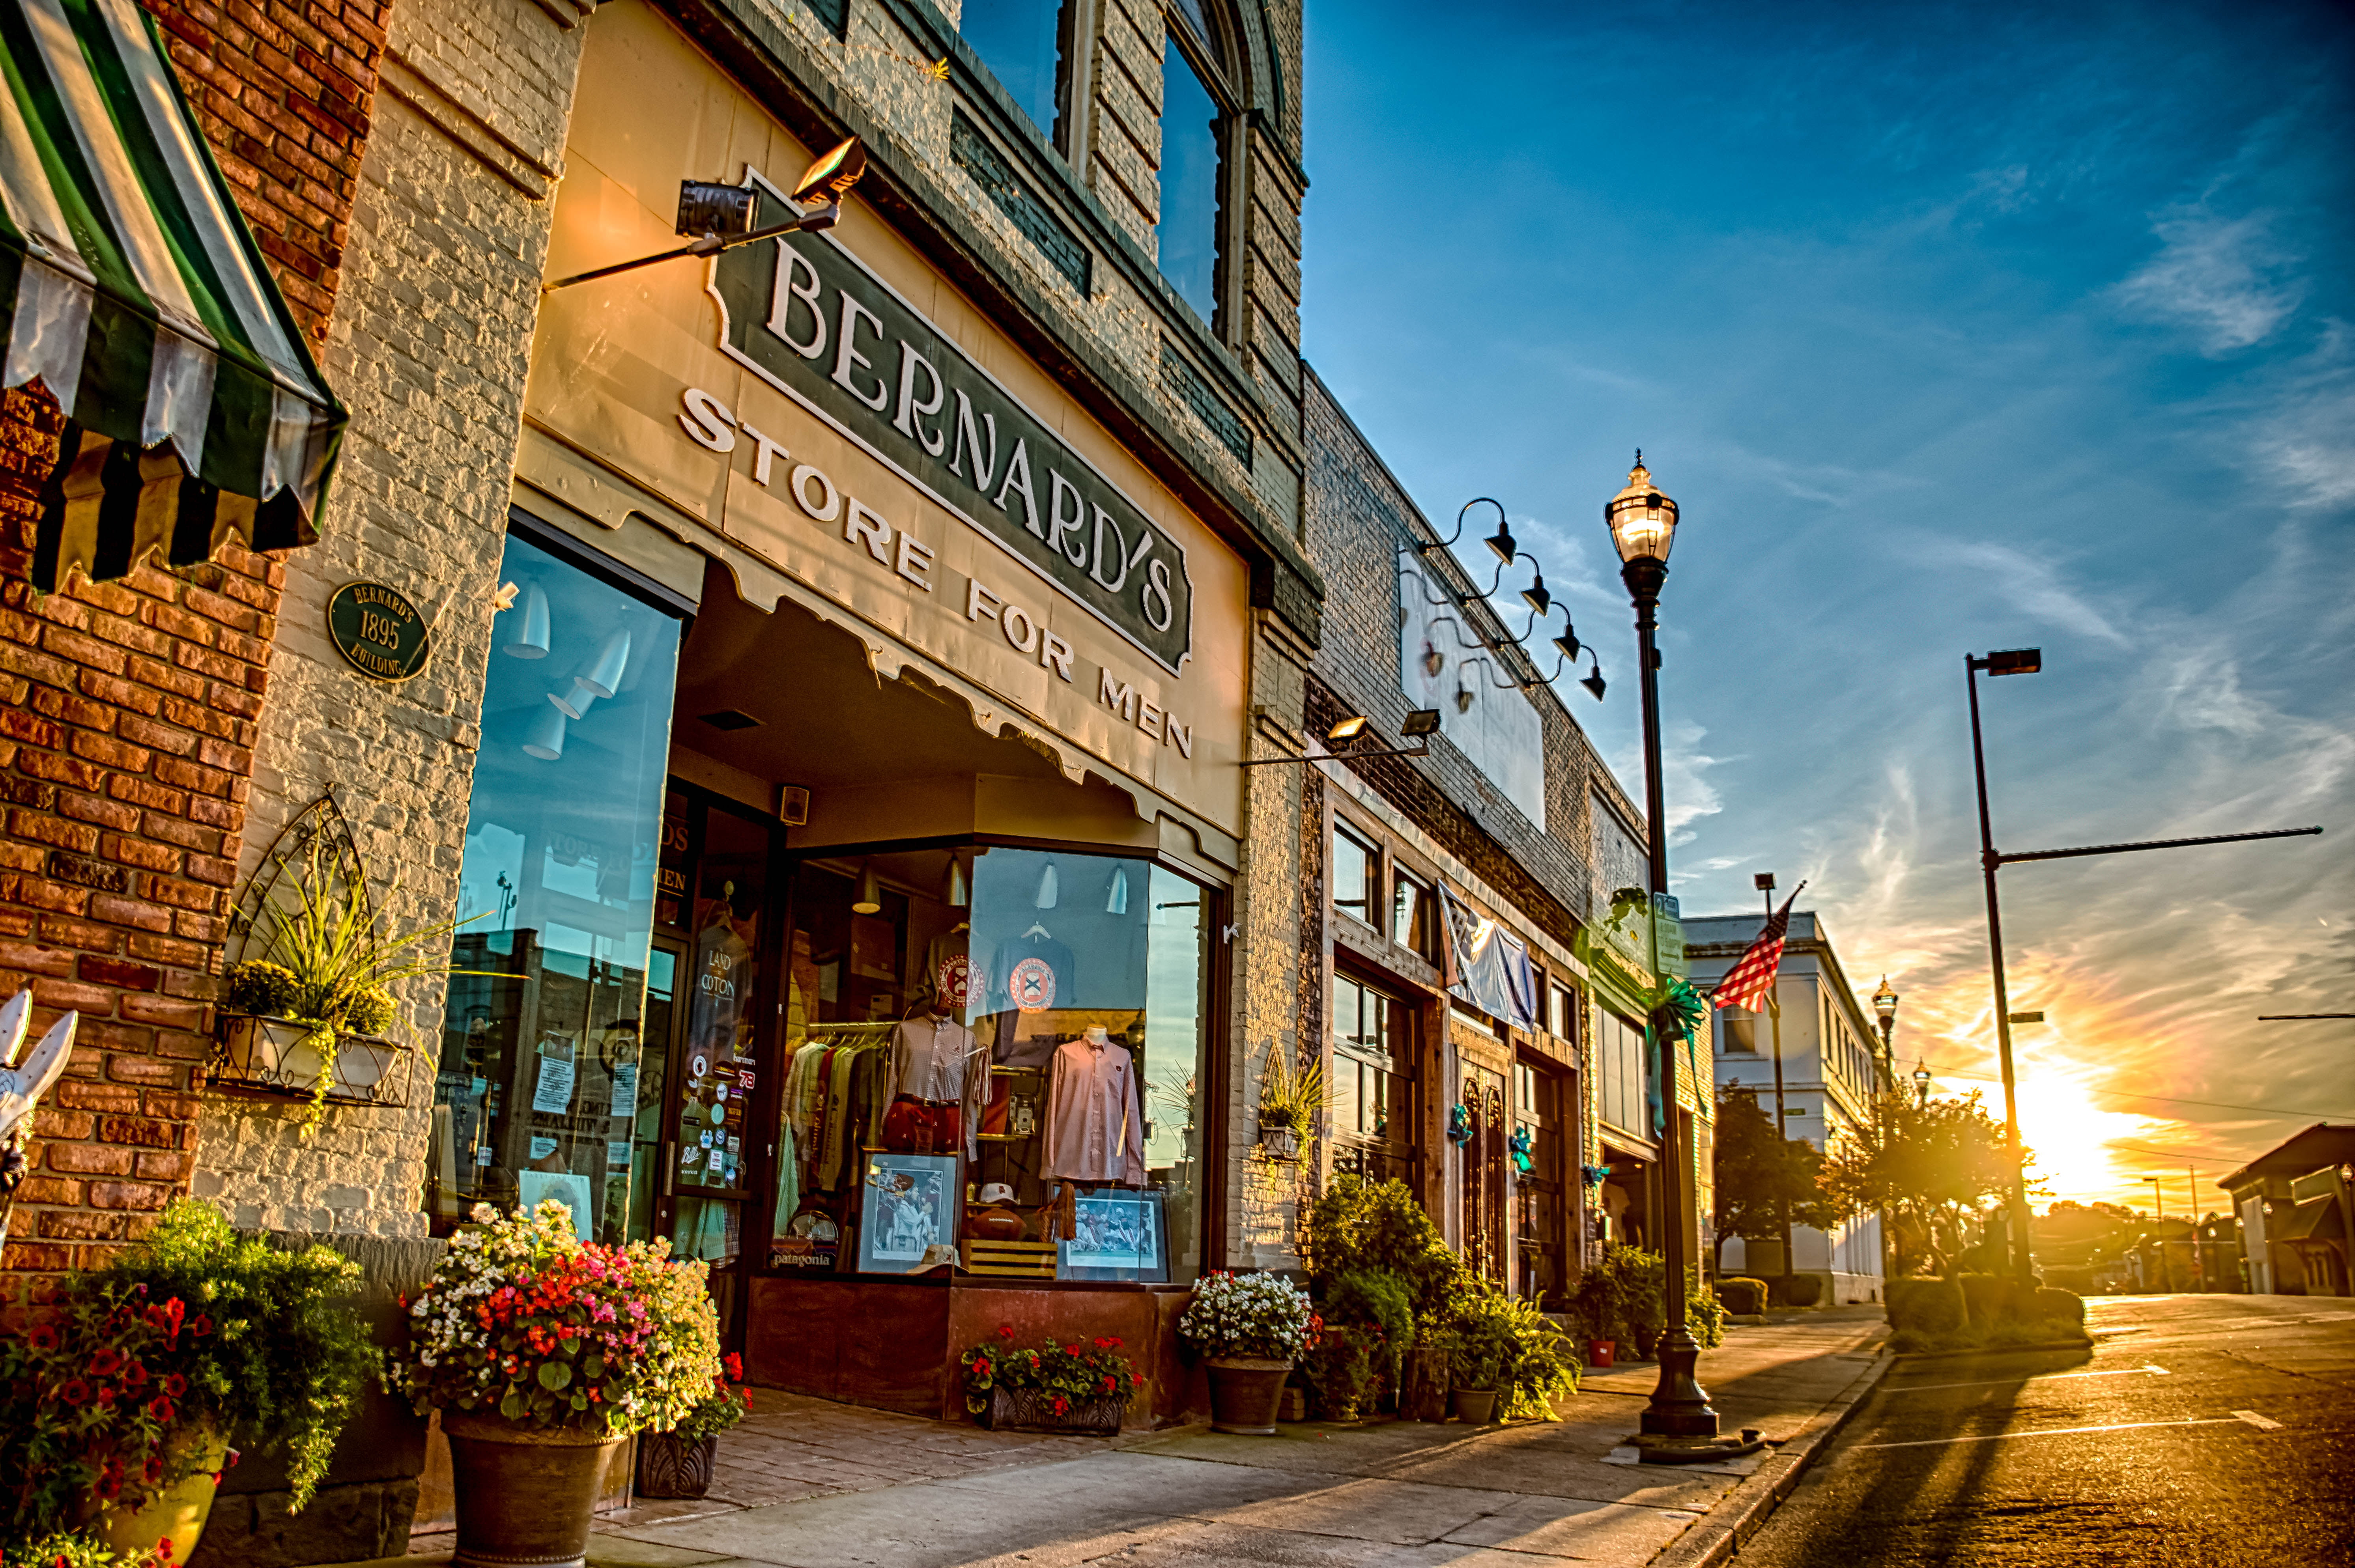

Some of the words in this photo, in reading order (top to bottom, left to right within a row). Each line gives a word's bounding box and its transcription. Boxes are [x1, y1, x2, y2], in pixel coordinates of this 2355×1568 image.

[766, 237, 1173, 633] BERNARD'S
[678, 387, 936, 594] STORE
[966, 578, 1075, 683] FOR
[1099, 666, 1193, 760] MEN
[353, 586, 415, 623] BERNARD'S
[360, 610, 401, 650] 1895
[350, 642, 402, 676] BUILDING
[1656, 898, 1663, 916] 2
[708, 950, 731, 970] LAND
[774, 1254, 830, 1267] patagonia
